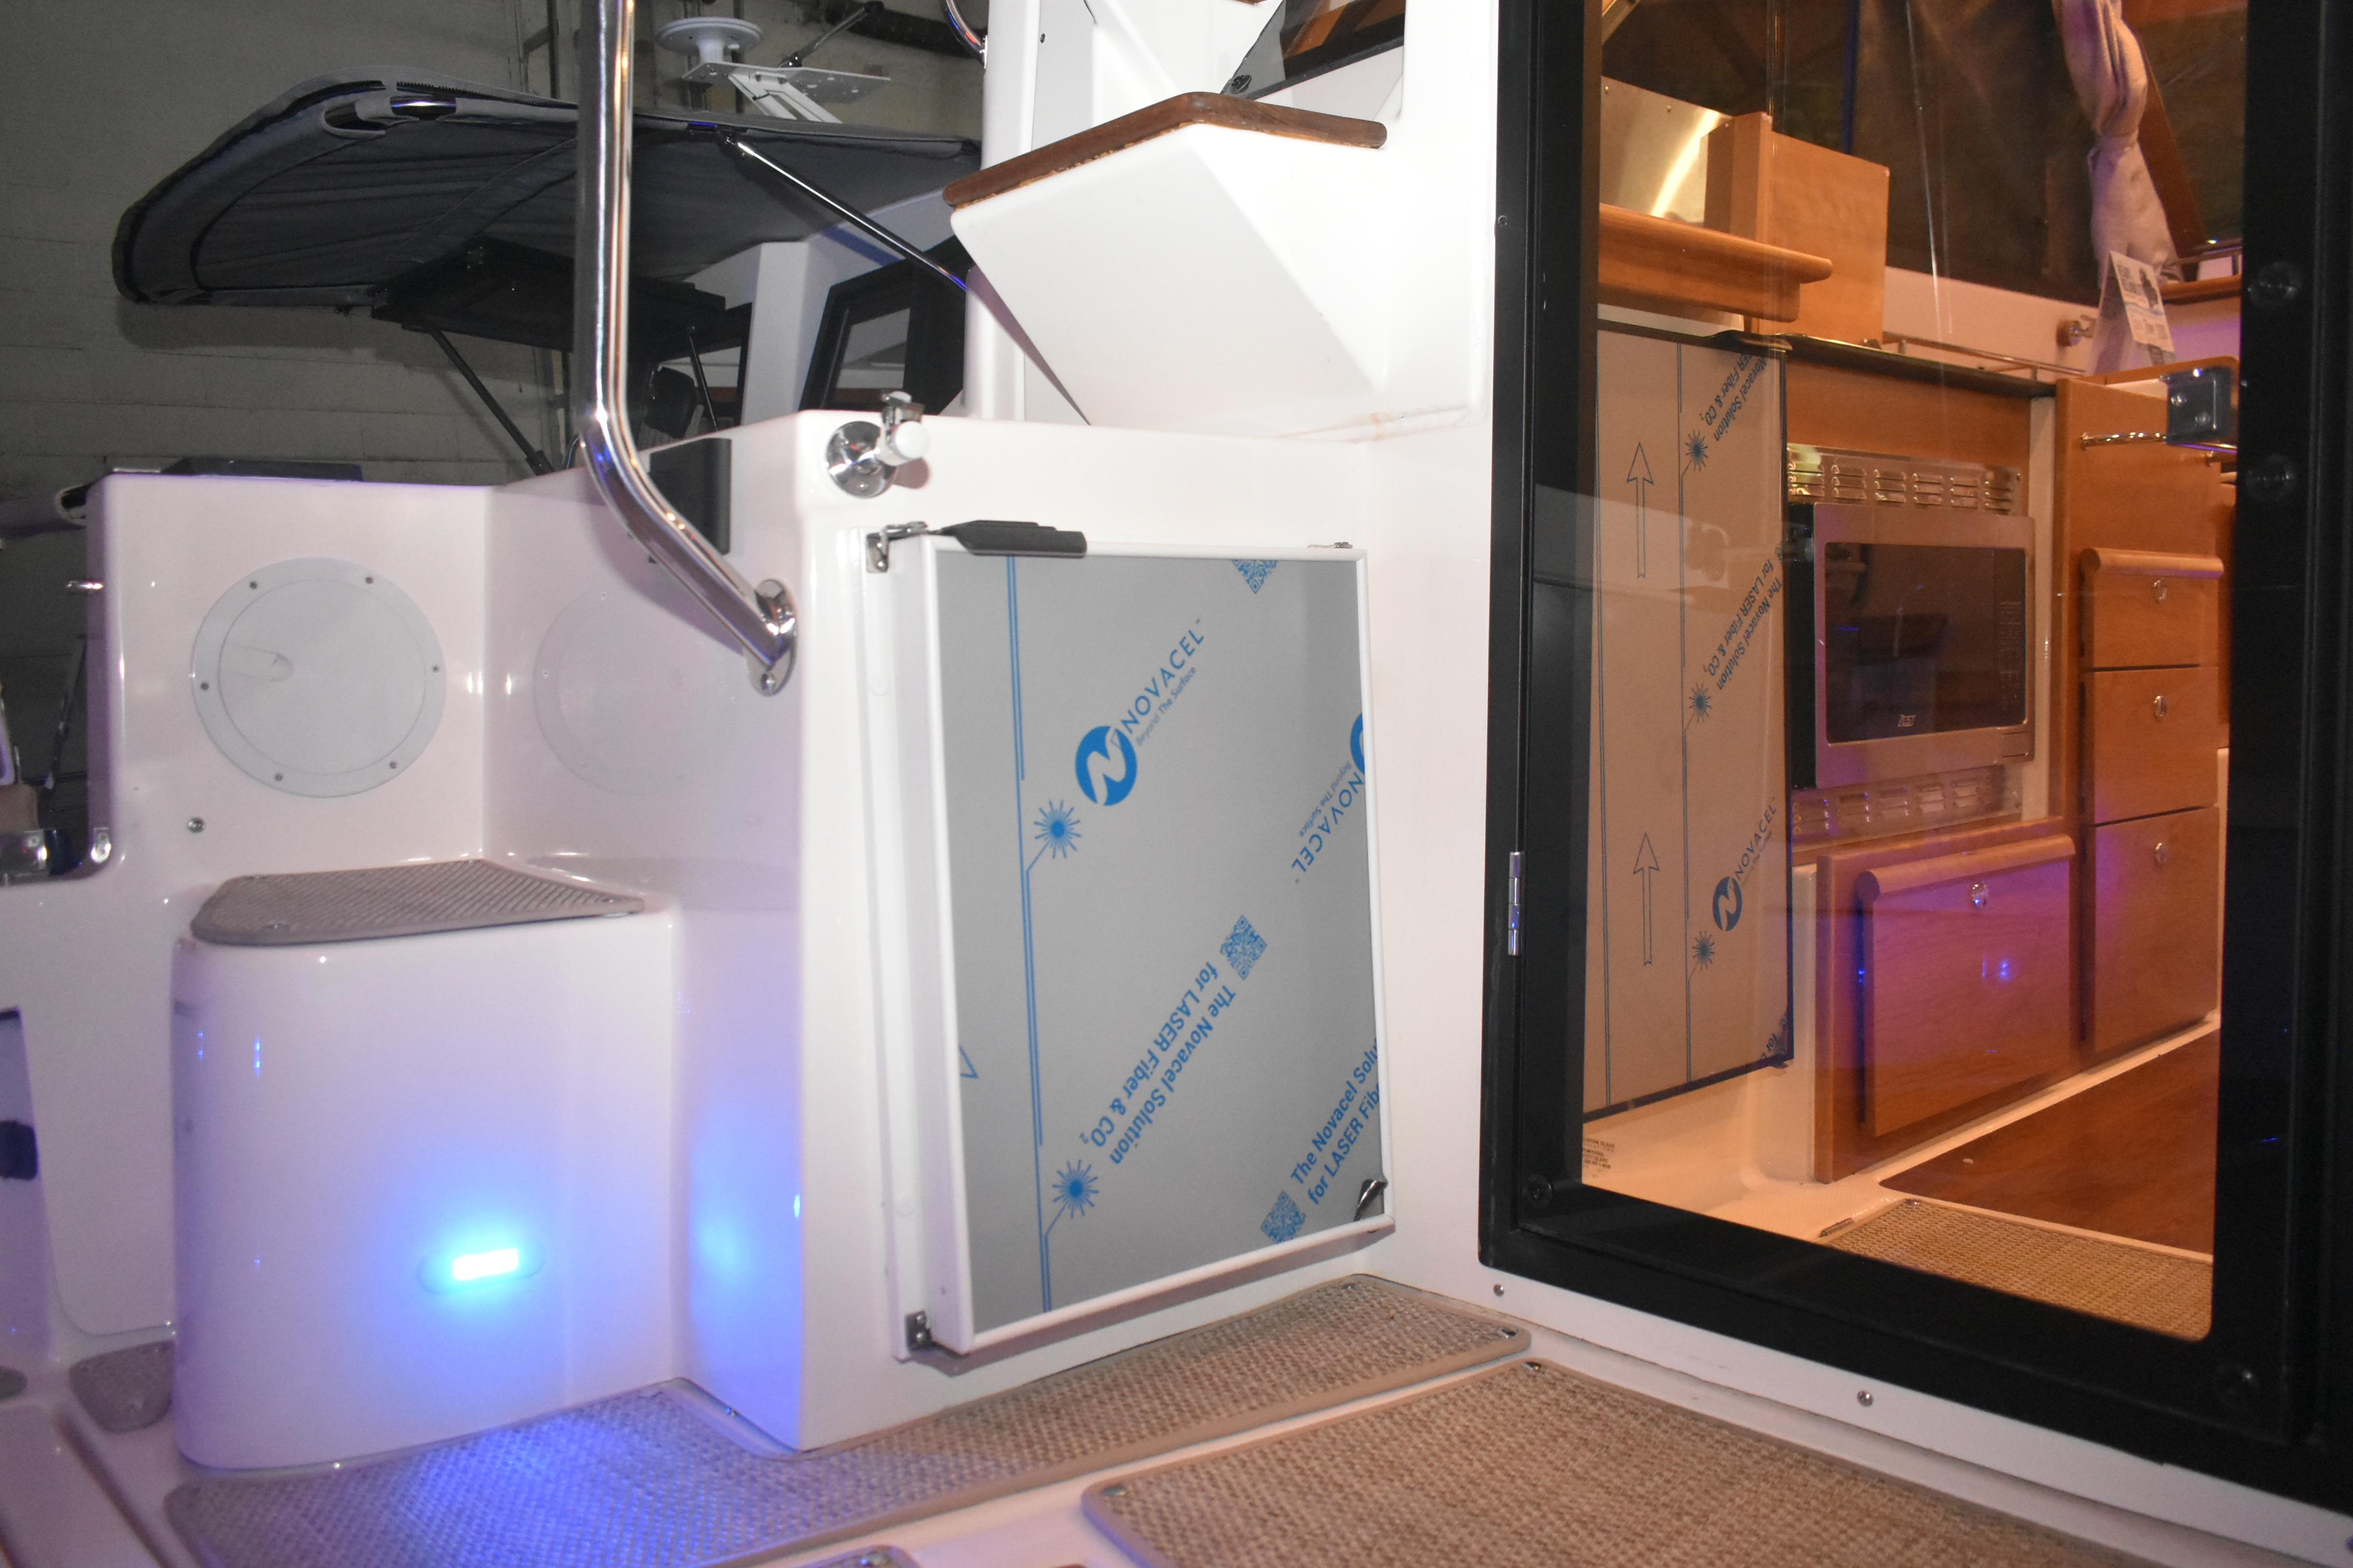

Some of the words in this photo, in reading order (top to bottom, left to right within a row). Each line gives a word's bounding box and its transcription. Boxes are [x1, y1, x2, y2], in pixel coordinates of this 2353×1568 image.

[1715, 394, 1723, 408] &
[1721, 367, 1740, 397] Fiber
[1713, 396, 1742, 442] Solution
[1762, 559, 1774, 578] for
[1769, 577, 1783, 598] The
[1741, 576, 1764, 617] LASER
[1724, 614, 1744, 646] Fiber
[1743, 597, 1771, 646] Novacel
[1717, 644, 1726, 657] &
[1717, 641, 1746, 690] Solution
[1121, 629, 1204, 734] NOVACEL
[1158, 698, 1173, 714] The
[1171, 667, 1196, 700] Surface
[1299, 806, 1321, 837] Surface
[1320, 791, 1332, 807] The
[1291, 772, 1365, 873] NOVACEL
[1734, 805, 1777, 880] NOVACEL
[1195, 961, 1218, 993] for
[1153, 989, 1200, 1052] LASER
[1208, 985, 1237, 1019] The
[1123, 1048, 1160, 1099] Fiber
[1160, 1016, 1214, 1093] Novacel
[1110, 1098, 1126, 1115] &
[1110, 1088, 1167, 1165] Solution
[1291, 1152, 1317, 1184] The
[1312, 1080, 1358, 1147] Novacel
[1353, 1038, 1377, 1084] Solu
[1308, 1175, 1329, 1205] for
[1324, 1118, 1364, 1178] LASER
[1359, 1082, 1380, 1120] Fib
